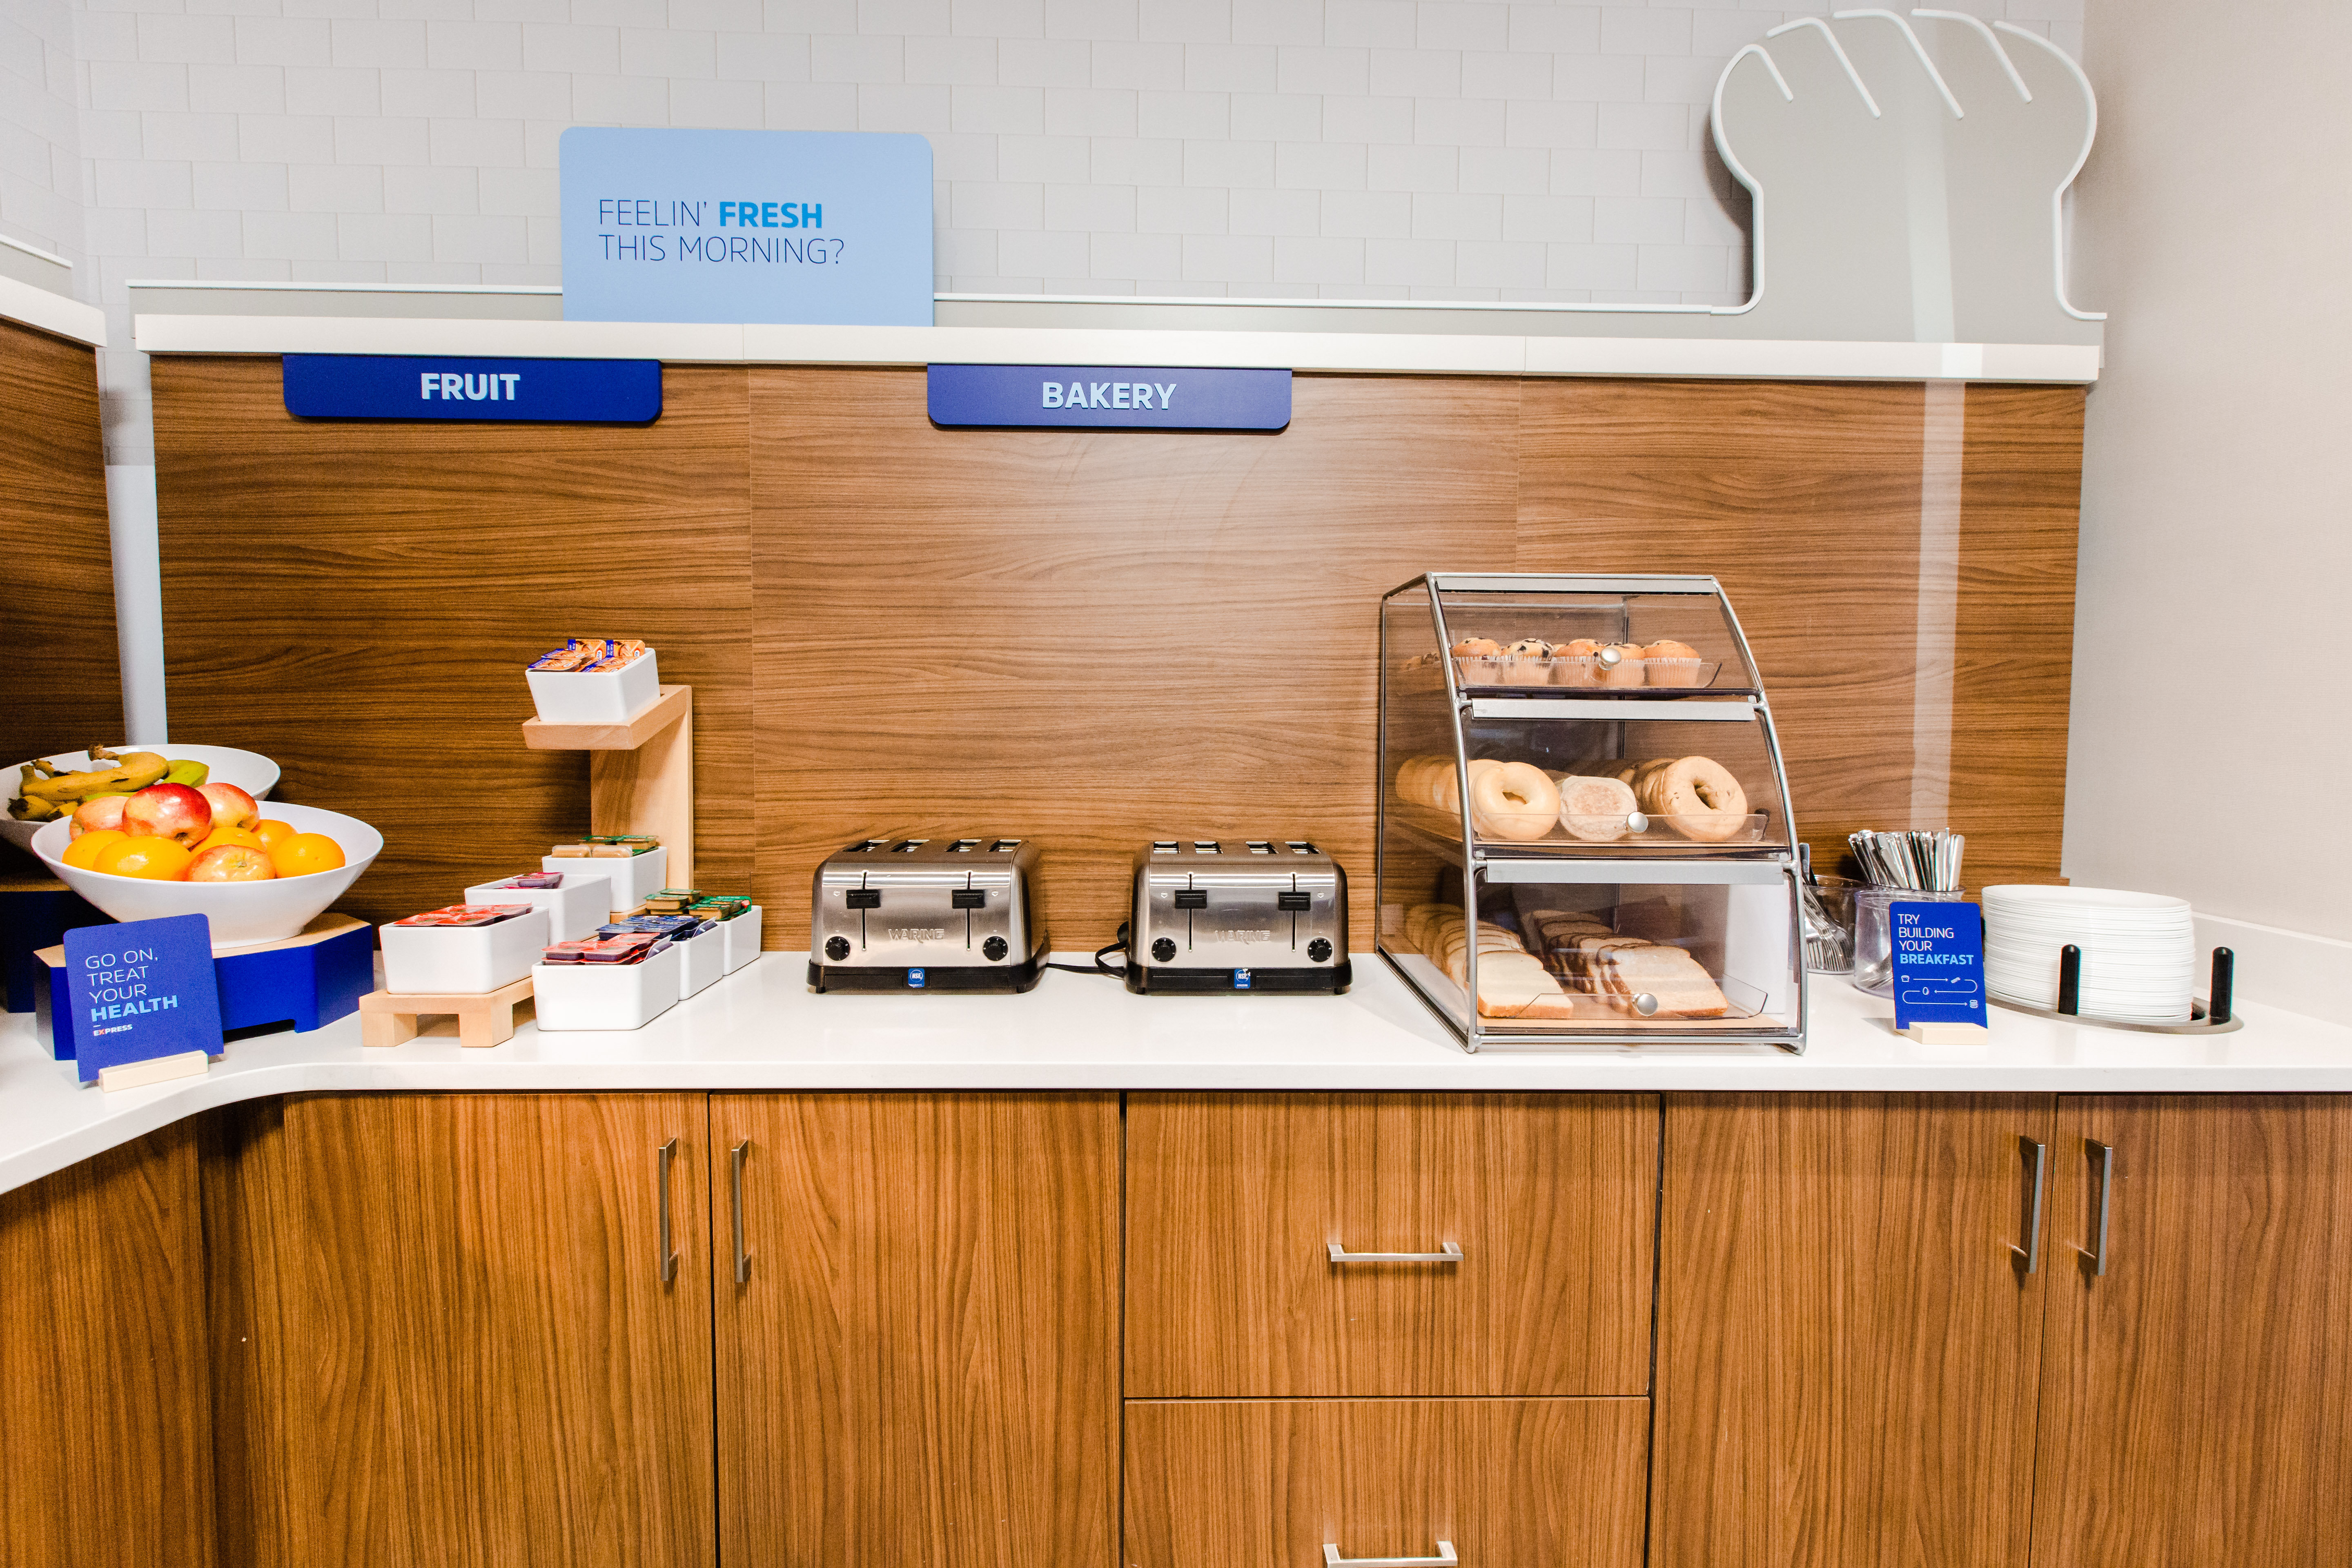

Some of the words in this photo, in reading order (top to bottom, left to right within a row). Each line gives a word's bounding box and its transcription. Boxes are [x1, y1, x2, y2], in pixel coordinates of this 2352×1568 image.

[599, 199, 707, 226] FEELIN'
[719, 202, 822, 228] FRESH
[598, 234, 666, 261] THIS
[679, 236, 844, 264] MORNING?
[421, 373, 521, 401] FRUIT
[1042, 382, 1177, 410] BAKERY
[1898, 914, 1920, 924] TRY
[889, 929, 944, 944] WARING
[1215, 930, 1270, 945] WARING
[1899, 927, 1954, 938] BUILDING
[1899, 940, 1932, 951] YOUR
[85, 953, 116, 969] GO
[124, 948, 158, 964] ON,
[1900, 954, 1974, 964] BREAKFAST
[87, 966, 149, 987] TREAT
[89, 984, 147, 1004] YOUR
[91, 995, 178, 1022] HEALTH
[93, 1024, 133, 1036] EXPRESS
